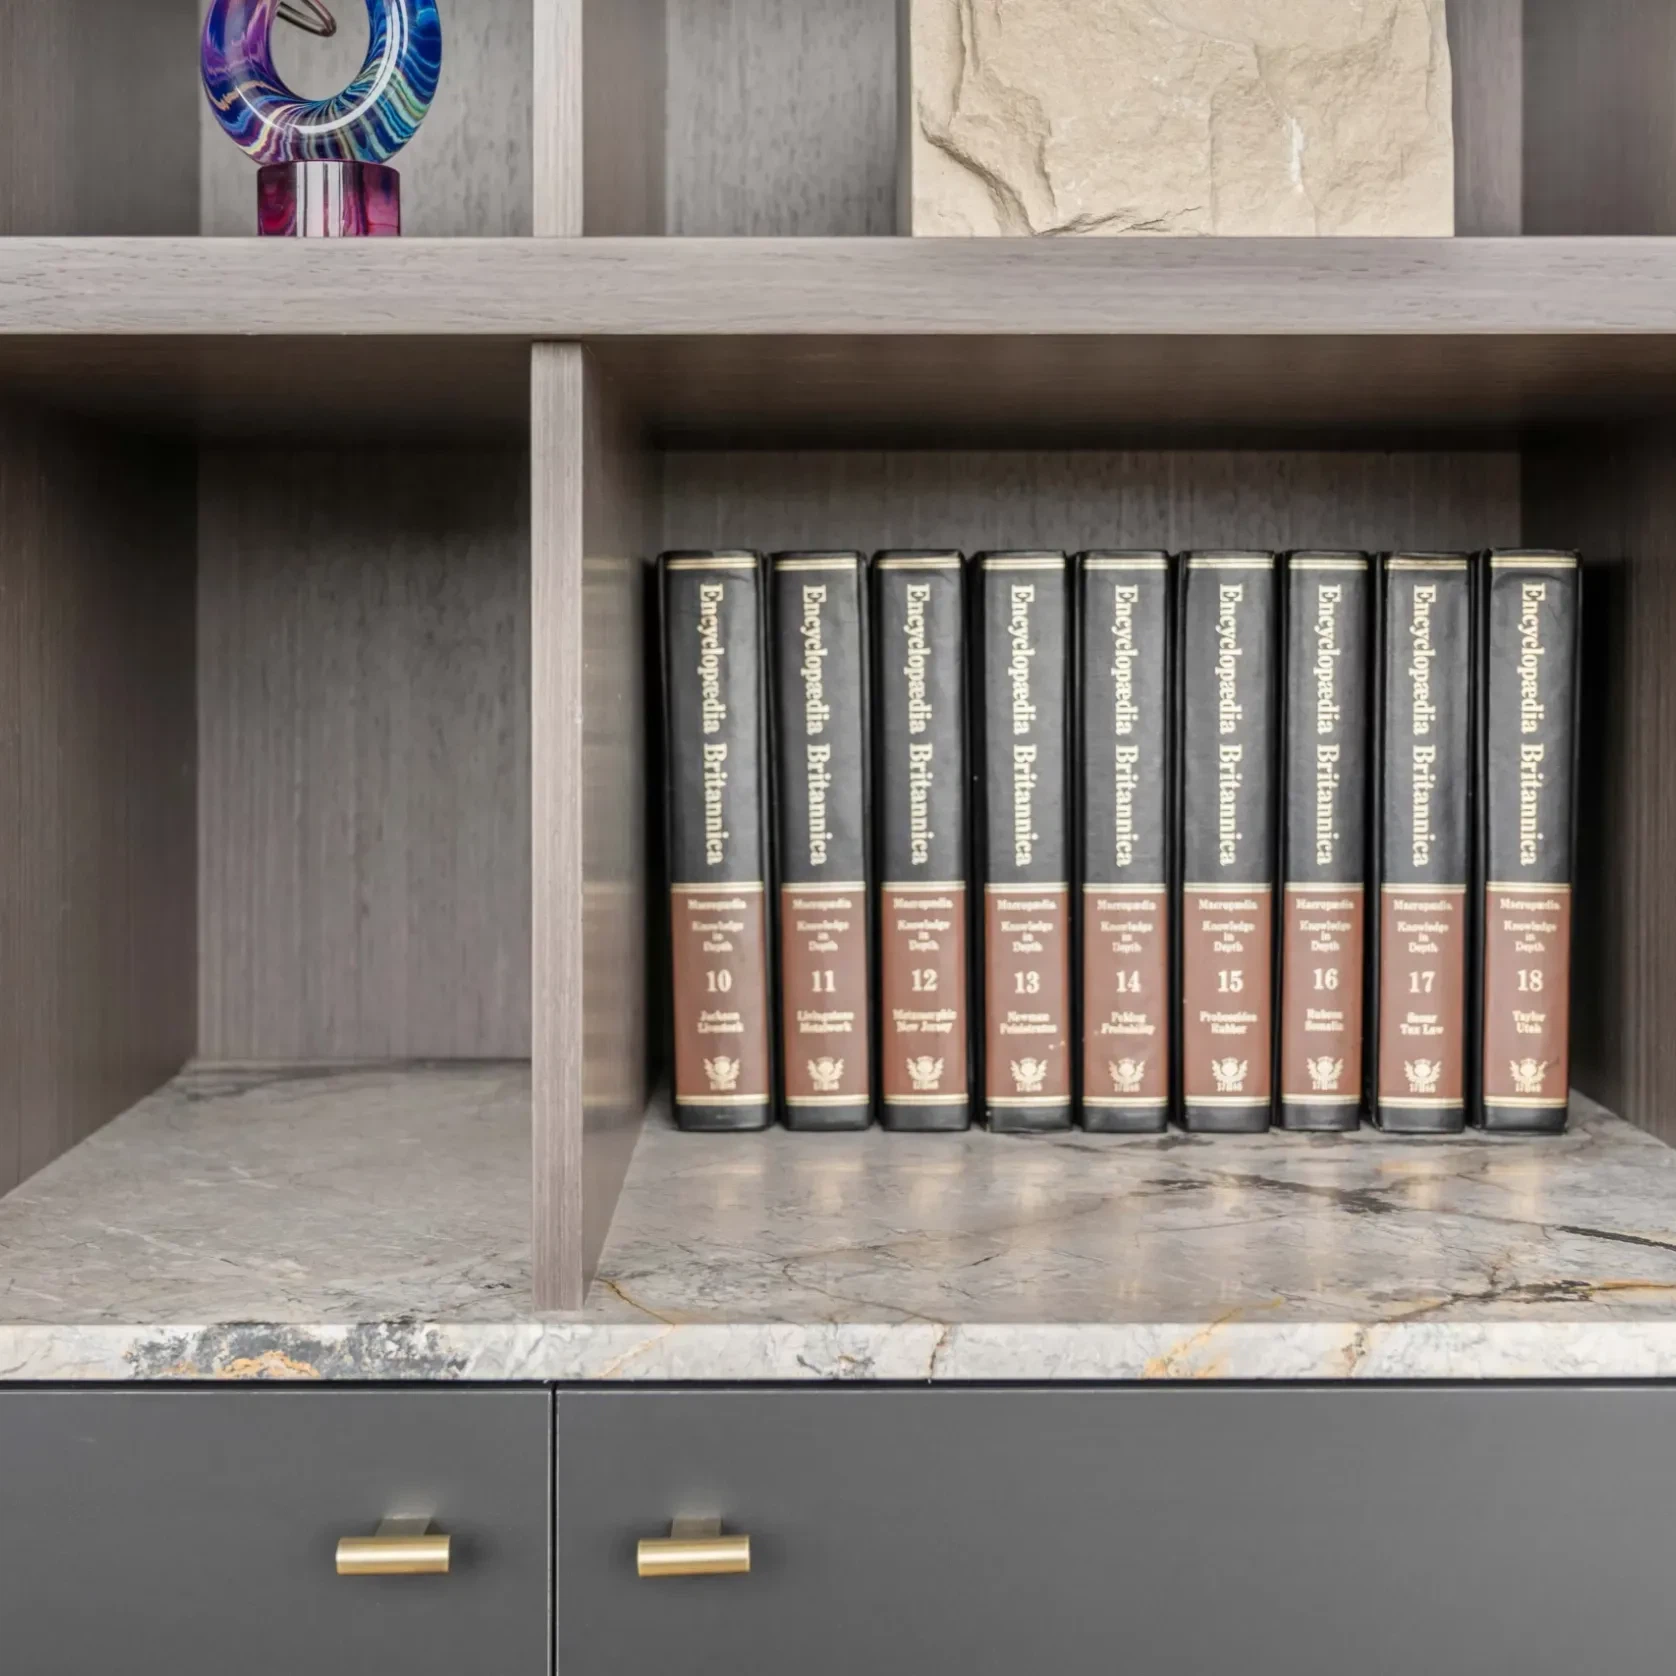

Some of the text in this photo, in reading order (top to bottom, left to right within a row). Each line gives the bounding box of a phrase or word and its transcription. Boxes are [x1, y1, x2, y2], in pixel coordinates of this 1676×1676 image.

[703, 743, 728, 865] Britannica
[806, 744, 832, 866] Britannica
[909, 743, 934, 865] Britannica
[1013, 745, 1038, 866] Britannica
[1115, 745, 1138, 867] Britannica
[1218, 744, 1242, 866] Britannica
[1315, 744, 1340, 865] Britannica
[1412, 745, 1436, 867] Britannica
[1520, 744, 1544, 865] Britannica
[707, 970, 732, 992] 10
[812, 970, 835, 992] 11
[912, 969, 937, 991] 12
[1015, 971, 1040, 993] 13
[1116, 971, 1141, 992] 14
[1218, 970, 1243, 992] 15
[1314, 968, 1338, 990] 16
[1410, 971, 1435, 993] 17
[1518, 970, 1543, 992] 18
